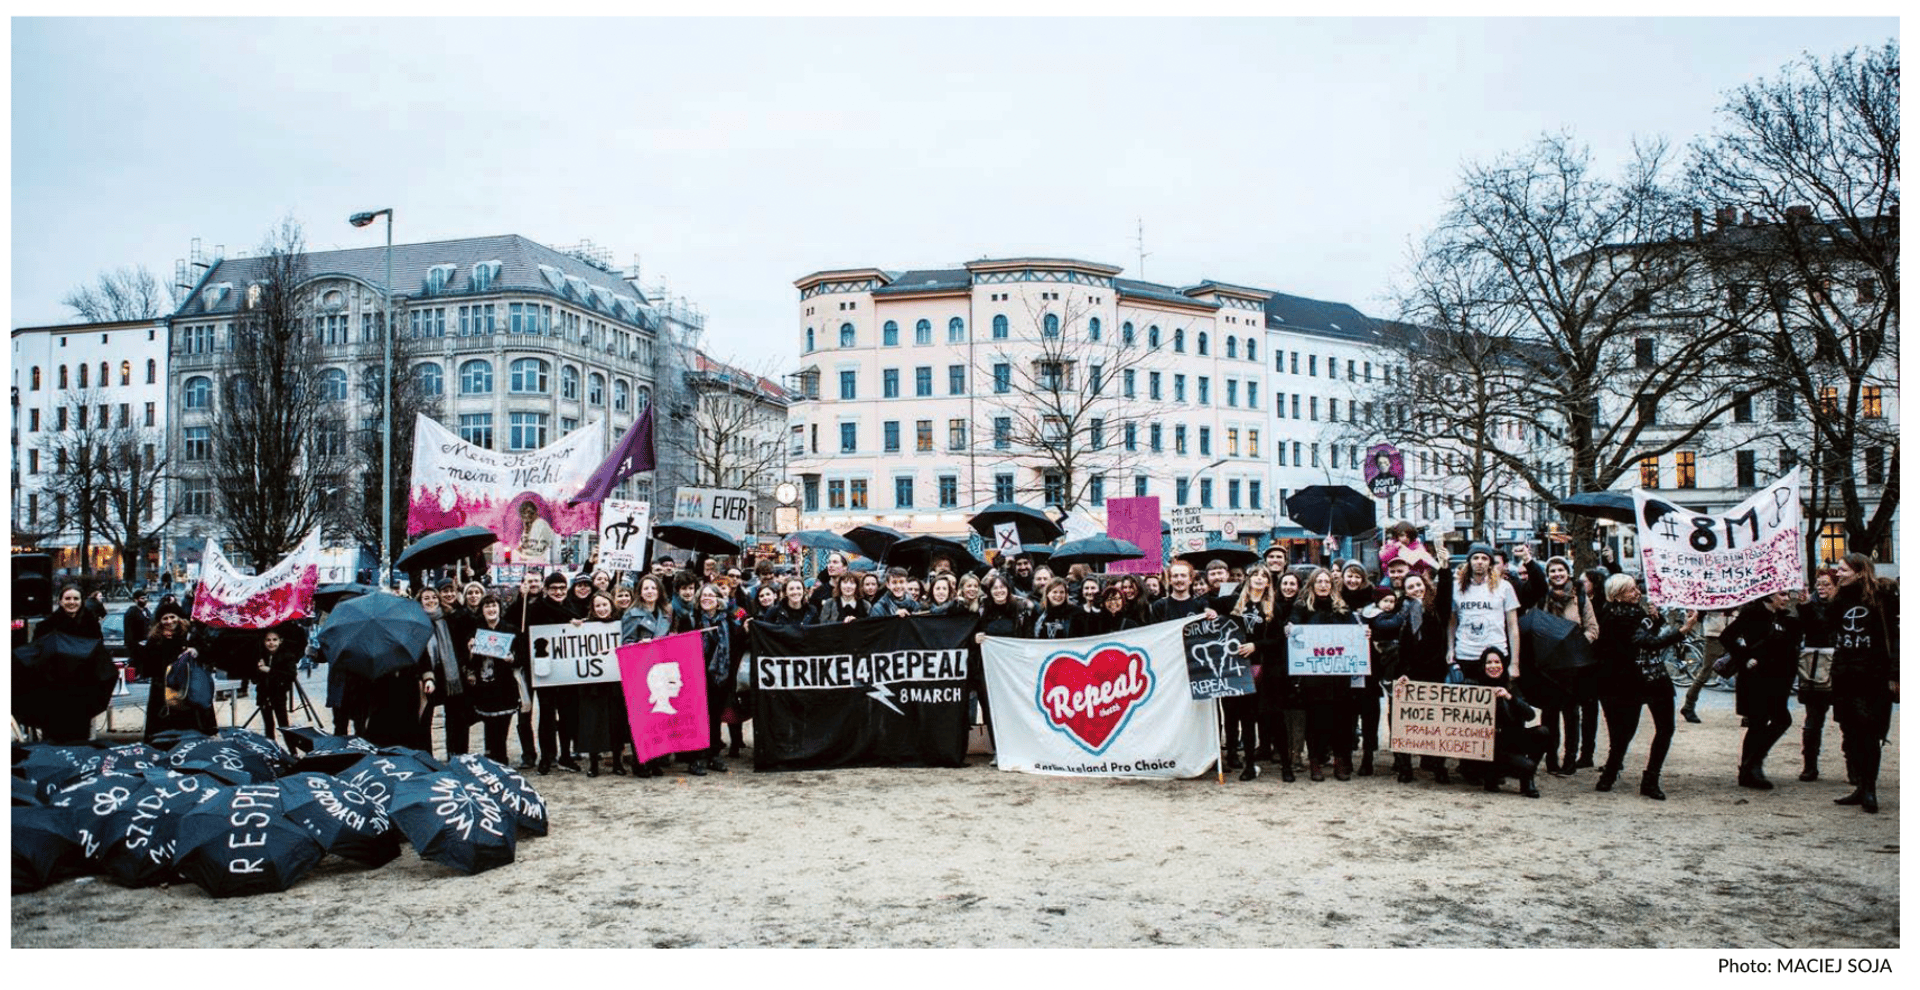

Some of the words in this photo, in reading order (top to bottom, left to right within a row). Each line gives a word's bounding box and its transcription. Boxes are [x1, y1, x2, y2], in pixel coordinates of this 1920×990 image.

[441, 443, 498, 467] Mein
[511, 464, 560, 488] Wahl
[711, 495, 747, 521] EVER
[1171, 508, 1183, 516] MY
[1184, 507, 1202, 515] BODY
[1172, 518, 1184, 526] MY
[1185, 516, 1201, 524] LIFE
[1173, 527, 1184, 535] MY
[1460, 601, 1493, 610] REPEAL
[1183, 617, 1221, 637] STRIKE
[551, 629, 621, 660] WITHOUT
[1313, 647, 1345, 657] NOT
[576, 658, 604, 678] US
[760, 656, 851, 687] STRIKE
[856, 657, 871, 683] 4
[874, 651, 965, 683] REPEAL
[1229, 657, 1246, 677] 4
[900, 688, 909, 704] 8
[911, 687, 962, 704] MARCH
[1046, 659, 1143, 718] Repeal
[1190, 678, 1230, 695] REPEAL
[1405, 684, 1492, 704] RESPEKTUJ
[1400, 707, 1435, 720] MOJE
[1441, 707, 1492, 726] PRAWA
[1404, 725, 1441, 736] PRAWA
[1110, 762, 1132, 772] Pro
[1134, 759, 1176, 771] Choice
